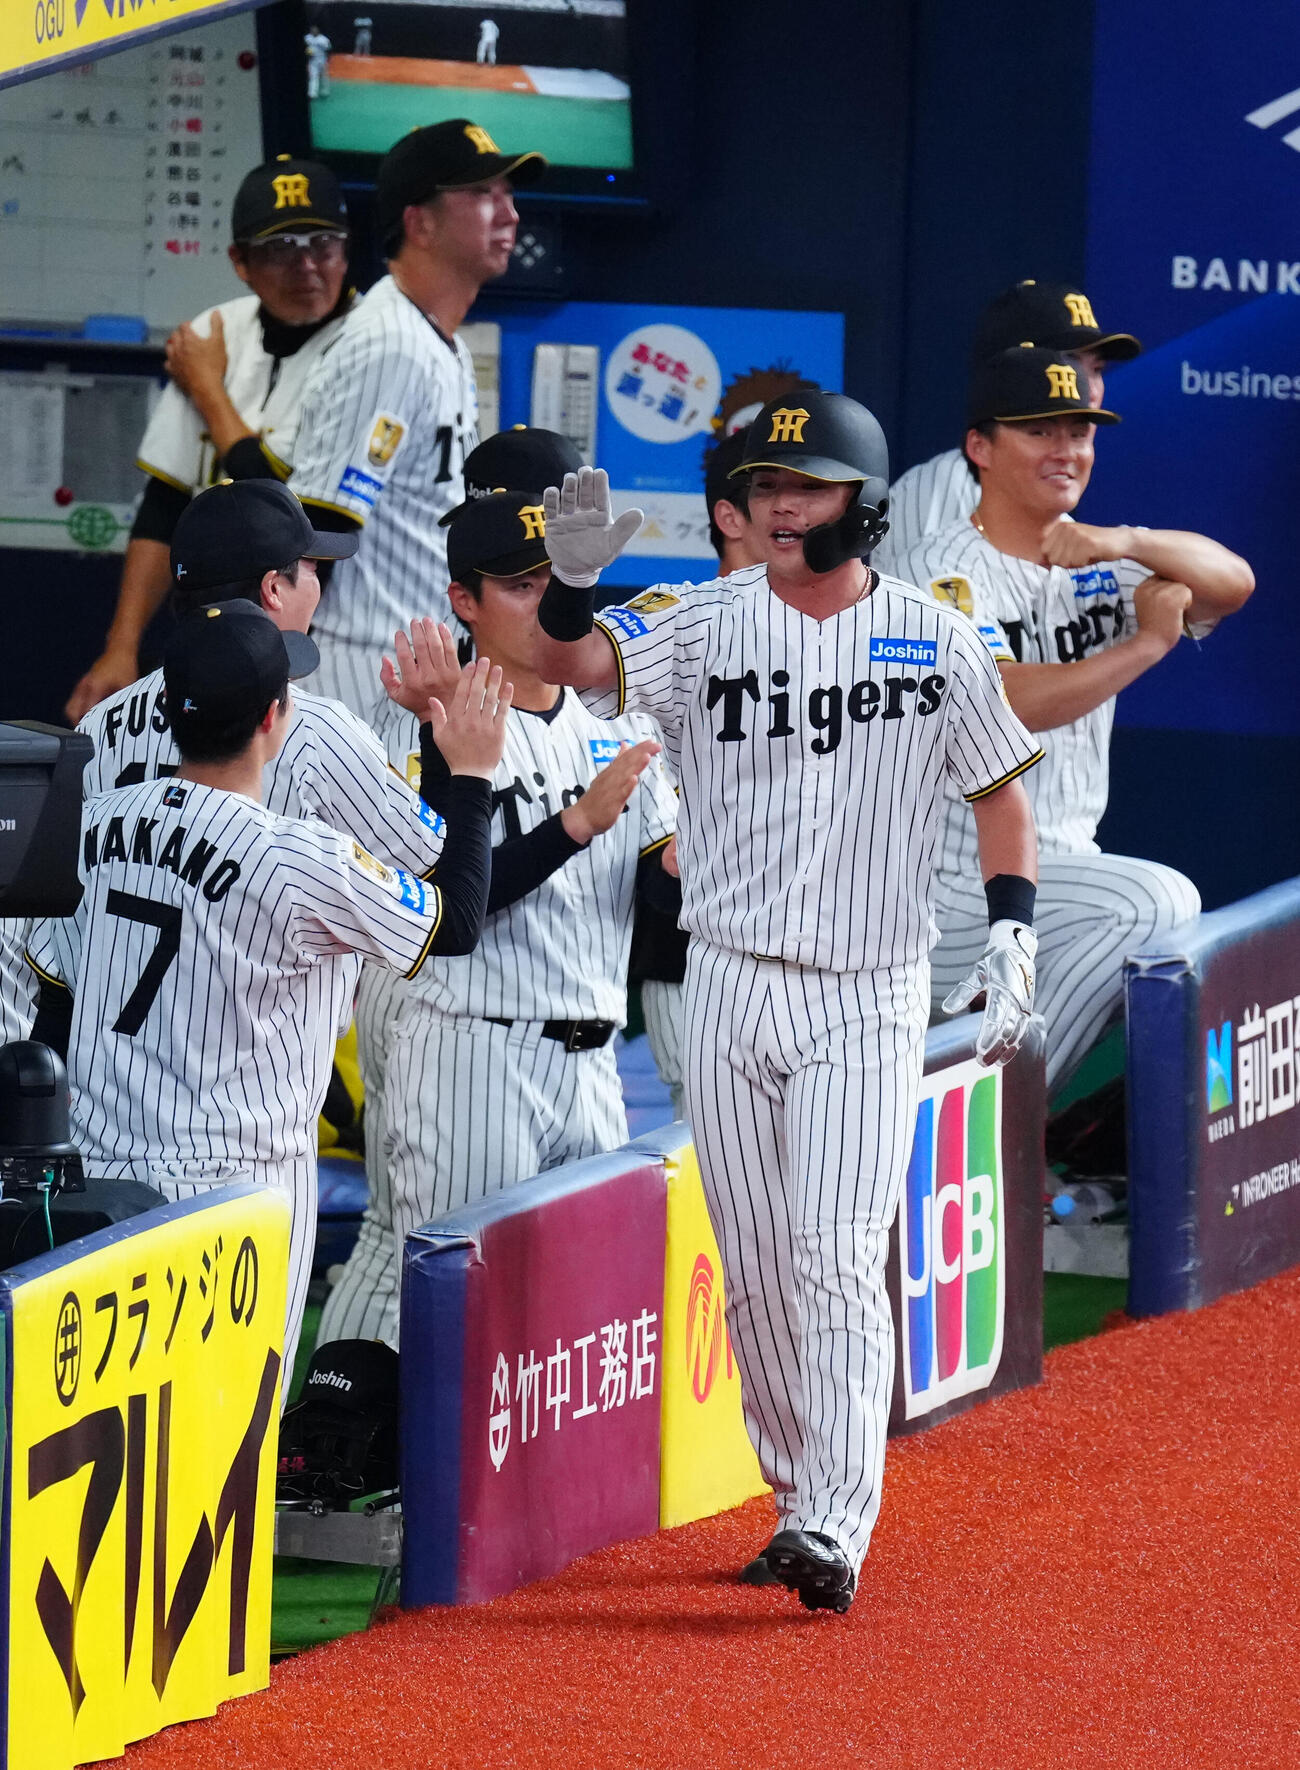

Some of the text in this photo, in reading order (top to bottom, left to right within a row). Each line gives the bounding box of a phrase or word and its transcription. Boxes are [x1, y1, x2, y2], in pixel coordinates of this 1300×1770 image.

[871, 641, 935, 663] Joshin
[706, 669, 946, 754] Tigers
[84, 816, 241, 903] NAKANO
[105, 888, 183, 1037] 7
[905, 1174, 995, 1298] JCB
[308, 1369, 353, 1392] Joshin
[515, 1308, 657, 1443] 竹中工務店
[28, 1346, 281, 1721] マルイ
